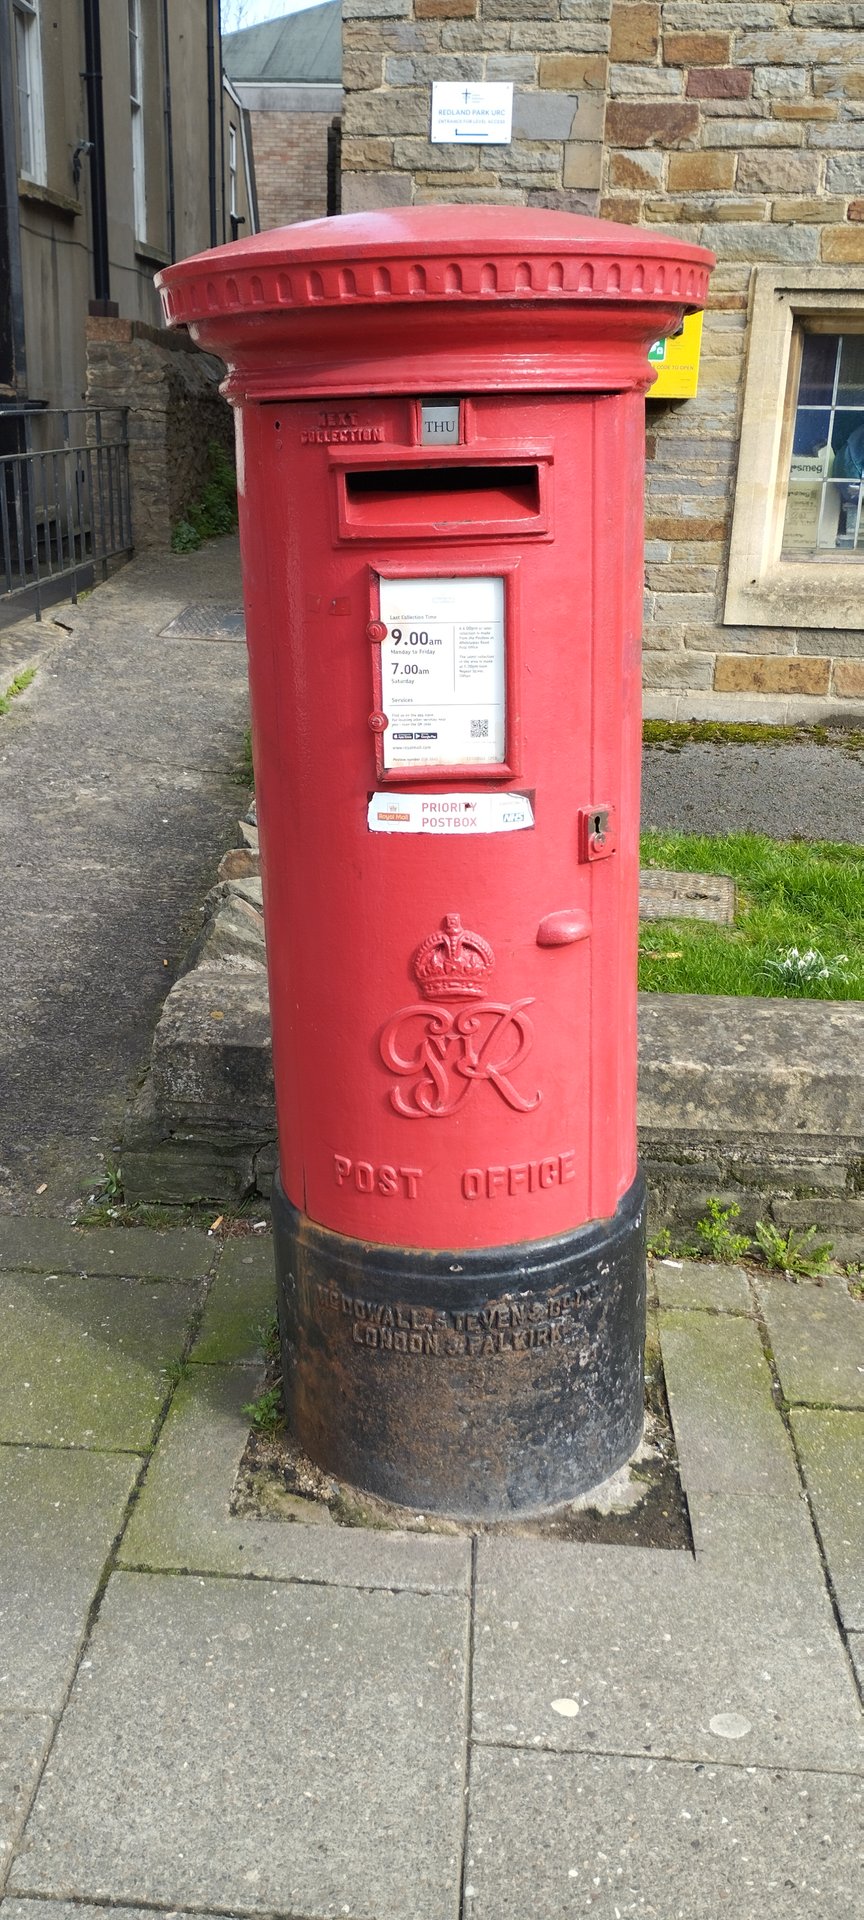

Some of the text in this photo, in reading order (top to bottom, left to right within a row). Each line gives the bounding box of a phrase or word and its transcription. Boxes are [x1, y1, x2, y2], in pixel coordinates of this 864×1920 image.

[424, 420, 455, 433] THU
[300, 426, 384, 444] COLLECTION
[797, 464, 823, 473] smeg
[391, 628, 442, 646] 9.00am
[391, 662, 430, 675] 7.00am
[421, 802, 478, 813] PRIORITY
[421, 817, 478, 828] POSTBOX
[503, 813, 525, 822] NHS
[334, 1149, 576, 1200] POST OFFICE
[353, 1322, 441, 1356] LONDON
